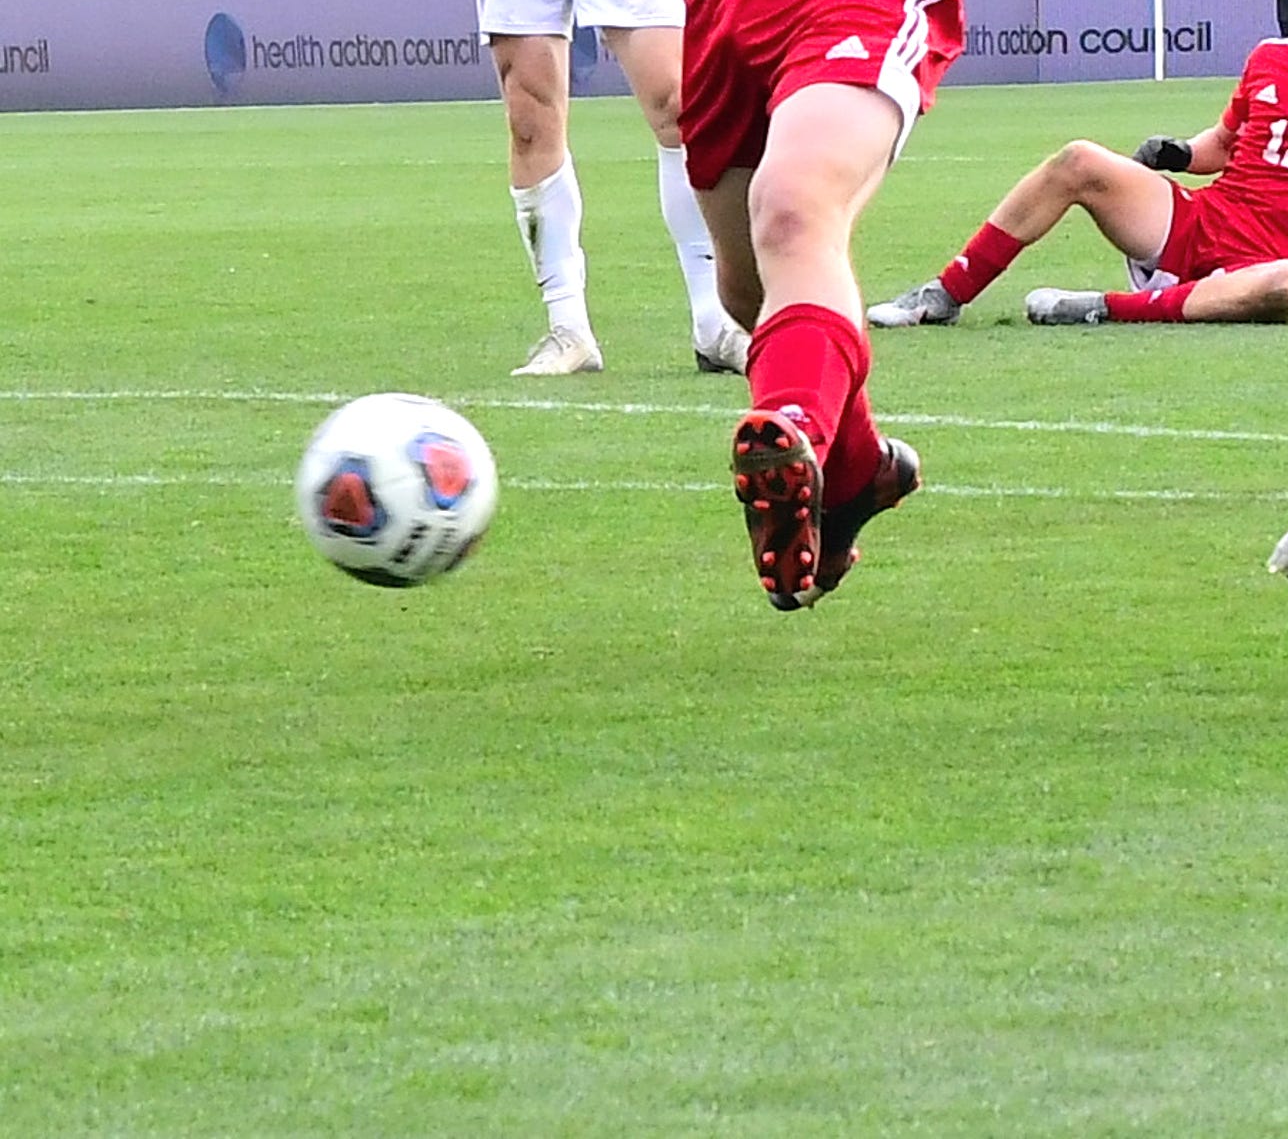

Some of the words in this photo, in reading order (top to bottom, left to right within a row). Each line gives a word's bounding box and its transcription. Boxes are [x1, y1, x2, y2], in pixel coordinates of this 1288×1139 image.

[252, 34, 325, 68] health
[329, 34, 398, 67] action
[403, 32, 480, 66] council
[998, 23, 1068, 55] action
